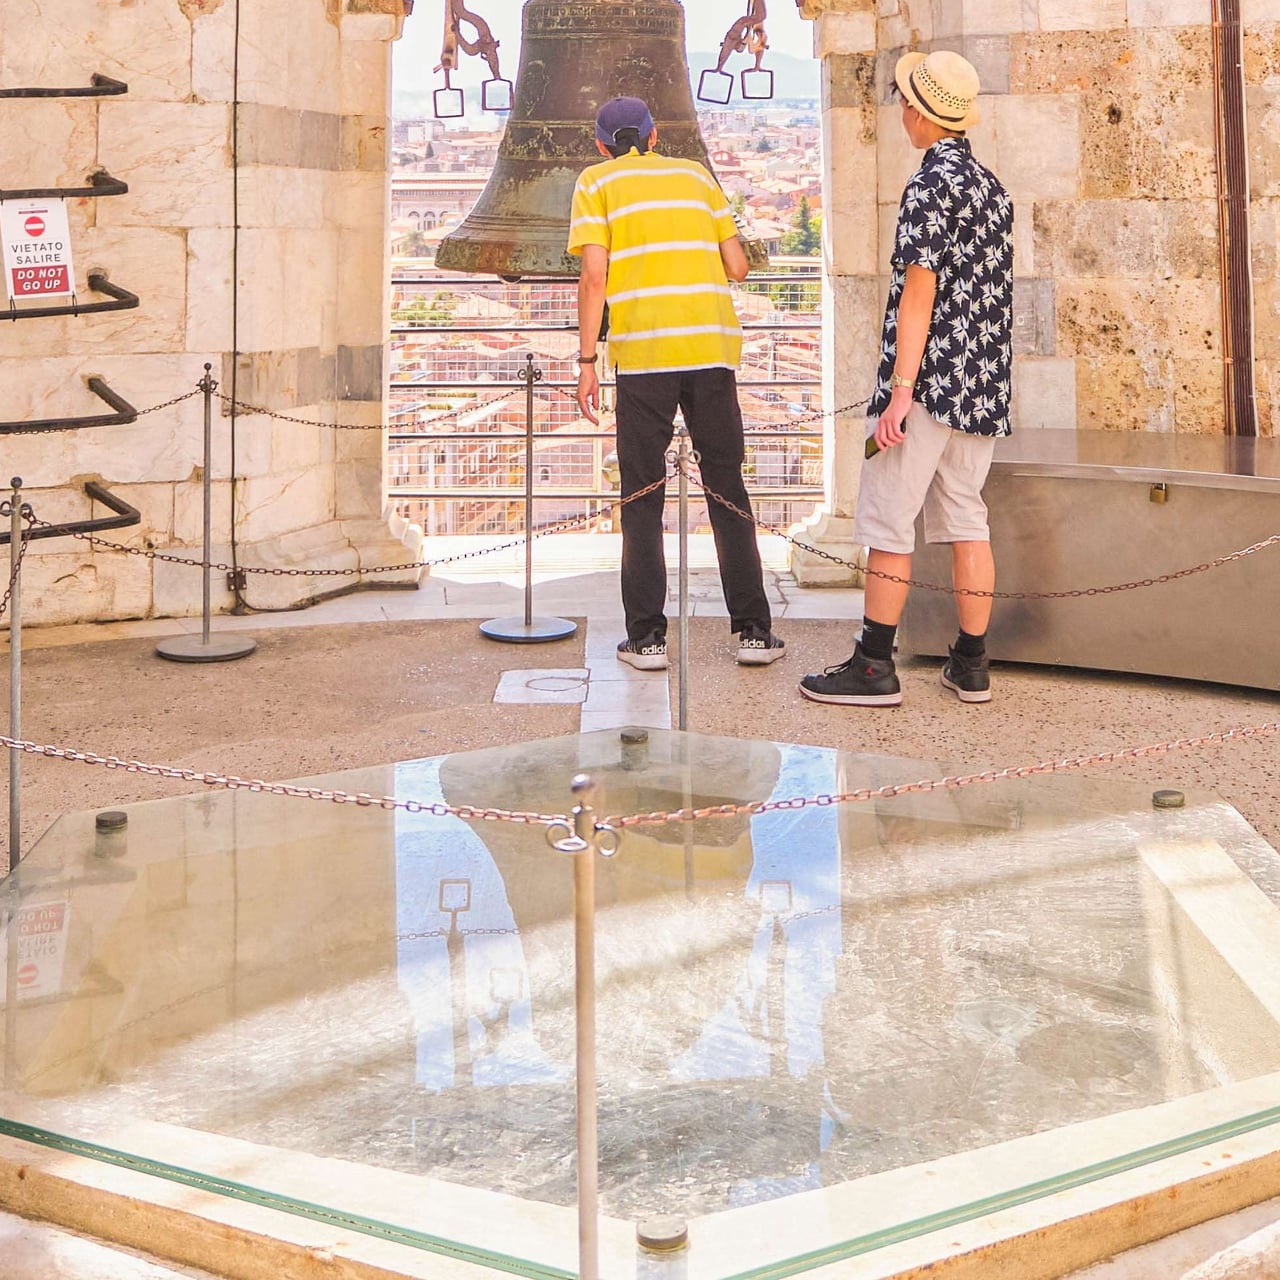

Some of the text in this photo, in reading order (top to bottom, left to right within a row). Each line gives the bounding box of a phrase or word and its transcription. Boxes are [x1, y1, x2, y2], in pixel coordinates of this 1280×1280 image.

[11, 241, 63, 253] VIETATO
[16, 253, 61, 265] SALIRE
[17, 267, 64, 280] DO NOT
[22, 279, 61, 291] GO UP
[641, 644, 667, 655] adid
[739, 638, 766, 649] didas
